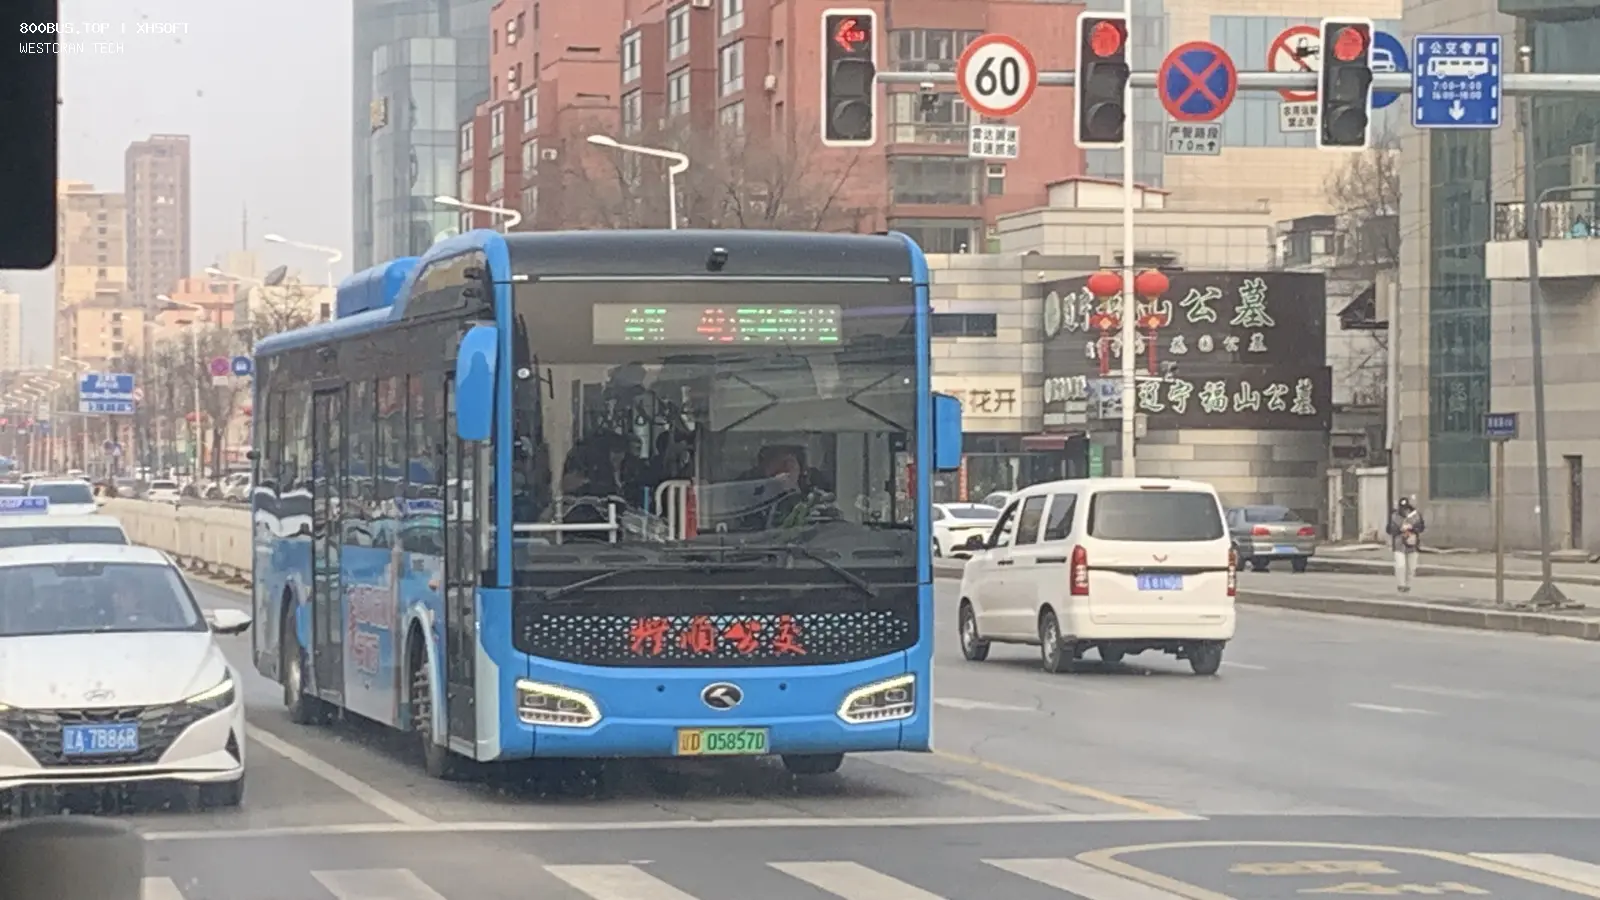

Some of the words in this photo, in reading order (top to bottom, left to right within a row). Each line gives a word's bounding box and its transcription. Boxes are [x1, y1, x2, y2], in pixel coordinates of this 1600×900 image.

[1430, 41, 1487, 55] 公交专用
[975, 57, 1020, 96] 60
[1137, 378, 1317, 415] 辽宁福山公墓
